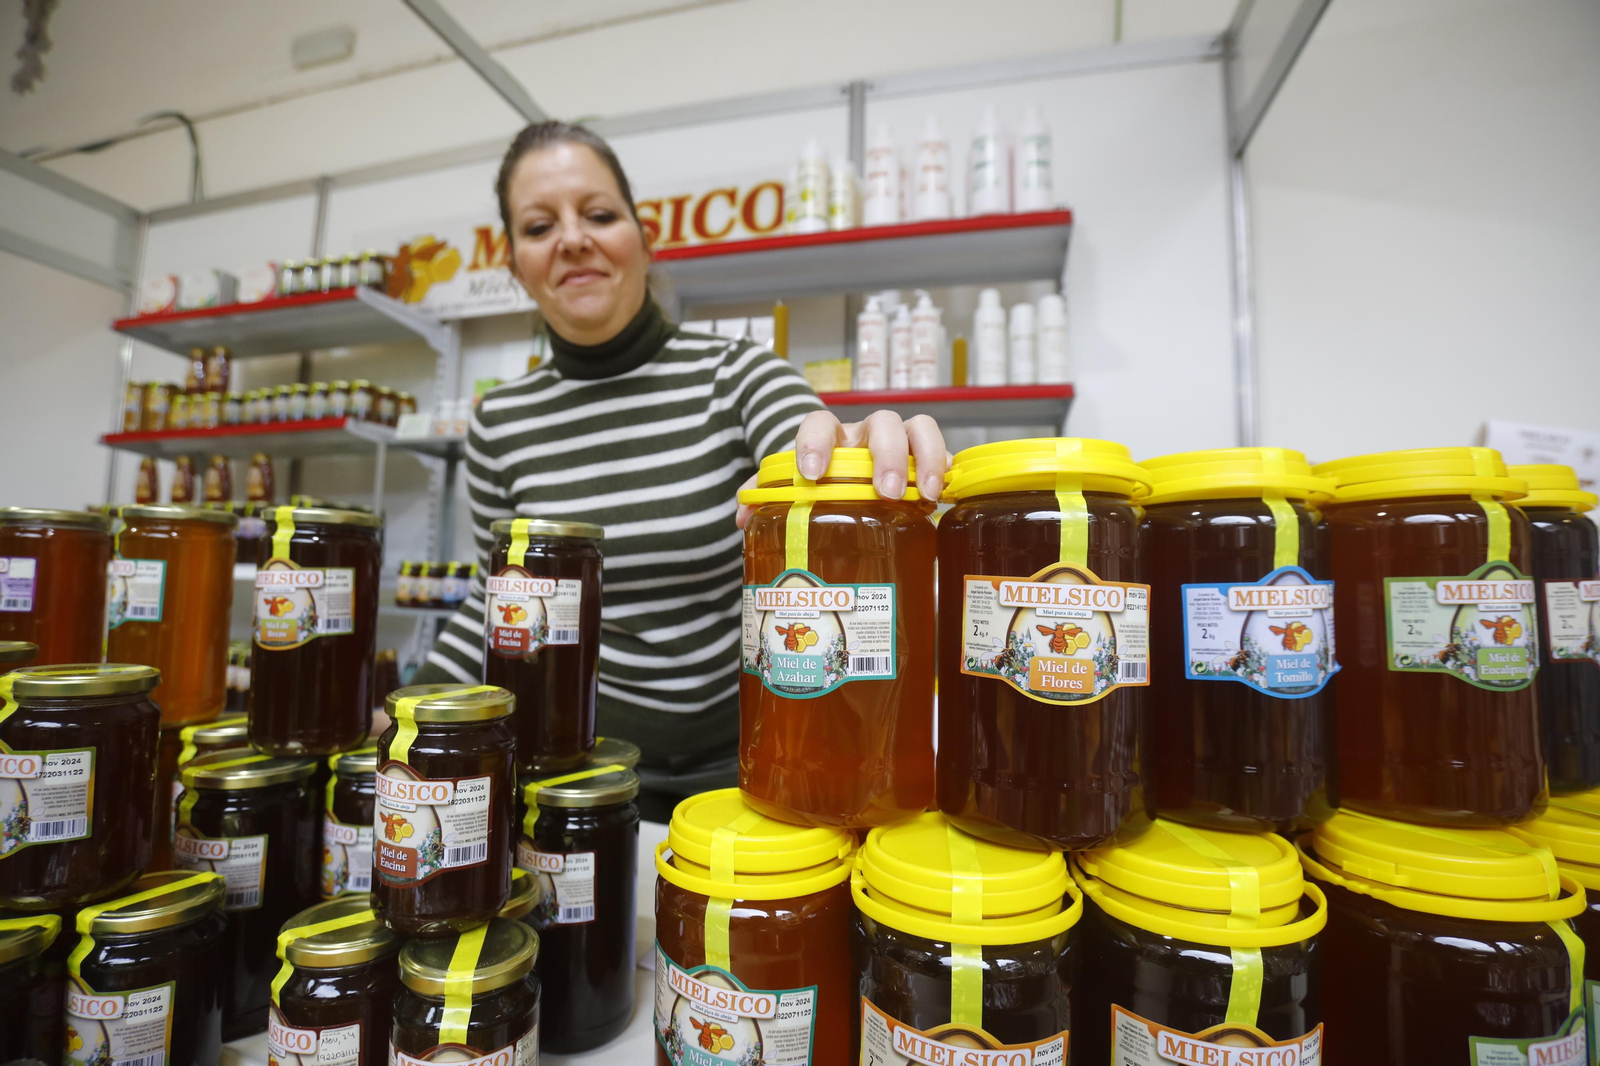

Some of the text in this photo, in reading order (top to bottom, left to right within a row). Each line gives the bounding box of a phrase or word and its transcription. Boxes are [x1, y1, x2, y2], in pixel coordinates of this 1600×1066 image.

[758, 590, 850, 607] MIELSICO
[1004, 585, 1120, 608] MIELSICO
[1234, 588, 1327, 606] MIELSICO
[499, 630, 522, 638] Miel de
[974, 625, 978, 636] 2
[1202, 628, 1208, 639] 2
[1408, 624, 1414, 635] 2
[777, 656, 816, 670] Miel de
[1276, 658, 1311, 669] Miel de
[1489, 653, 1520, 662] Miel de
[1038, 660, 1088, 674] Miel de
[777, 671, 816, 683] Azahar
[1041, 675, 1083, 689] Flores
[1274, 672, 1313, 683] Tomillo
[61, 758, 81, 766] 2024
[376, 776, 448, 802] IELSICO
[470, 784, 484, 792] 2024
[381, 845, 408, 860] Miel de
[381, 857, 406, 872] Encina
[670, 968, 771, 1015] MIELSICO
[142, 995, 161, 1004] 2024
[796, 998, 810, 1006] 2024
[117, 1005, 163, 1019] 722031122
[899, 1031, 1026, 1066] MIELSICO
[1037, 1049, 1049, 1057] nov
[1164, 1035, 1296, 1066] MIELSICO
